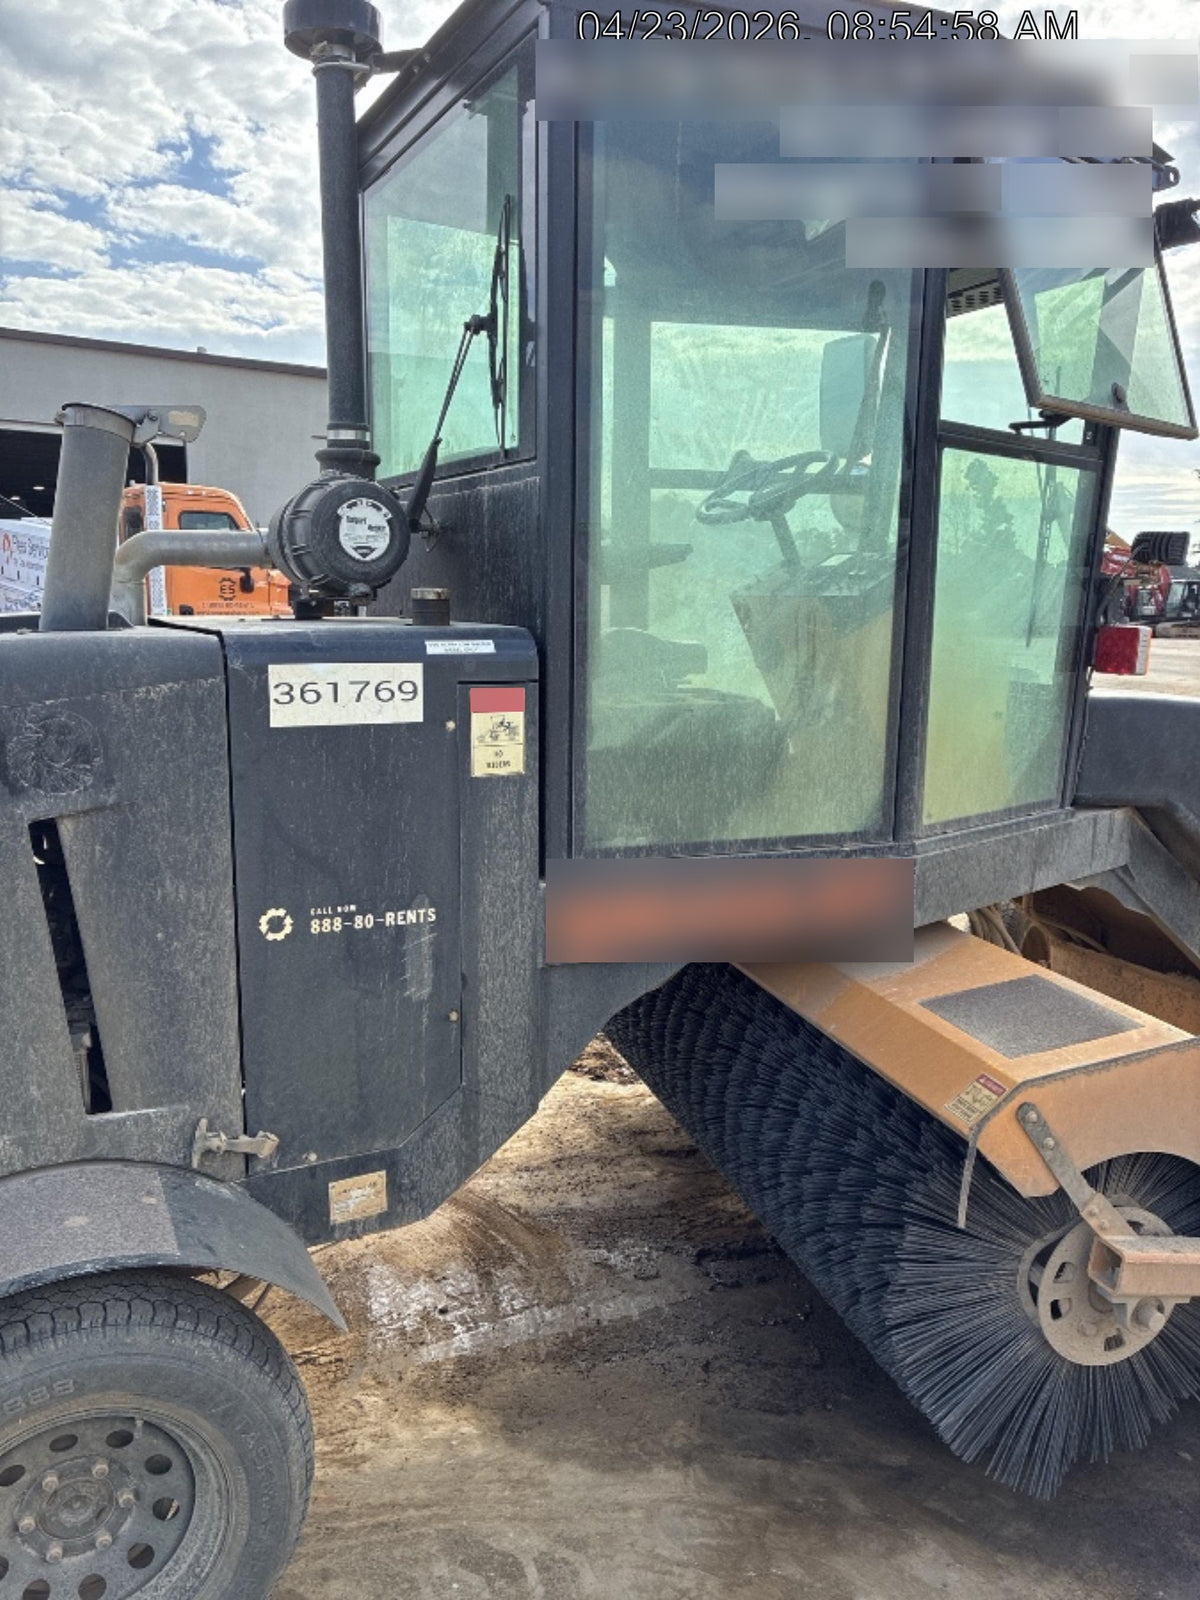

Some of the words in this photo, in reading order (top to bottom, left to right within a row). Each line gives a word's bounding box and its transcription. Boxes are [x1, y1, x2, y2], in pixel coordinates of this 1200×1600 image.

[273, 680, 418, 704] 361769
[310, 906, 333, 916] CALL
[337, 904, 357, 913] NOW
[310, 908, 436, 934] 888-80-RENTS
